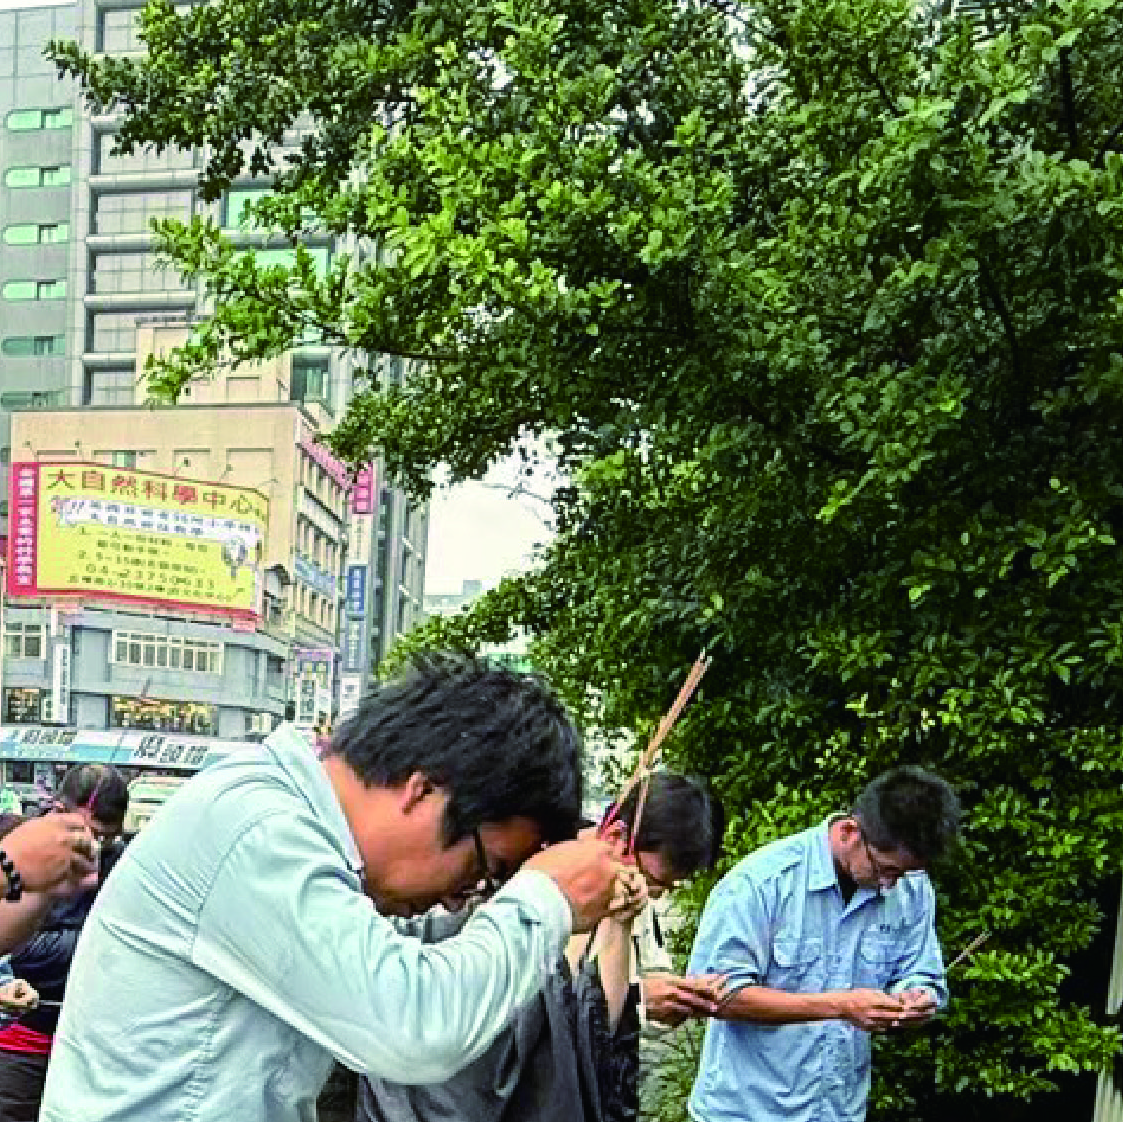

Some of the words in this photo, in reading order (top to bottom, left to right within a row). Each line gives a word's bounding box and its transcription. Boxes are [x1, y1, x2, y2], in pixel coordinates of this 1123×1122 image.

[46, 468, 253, 515] 大自然科學中心
